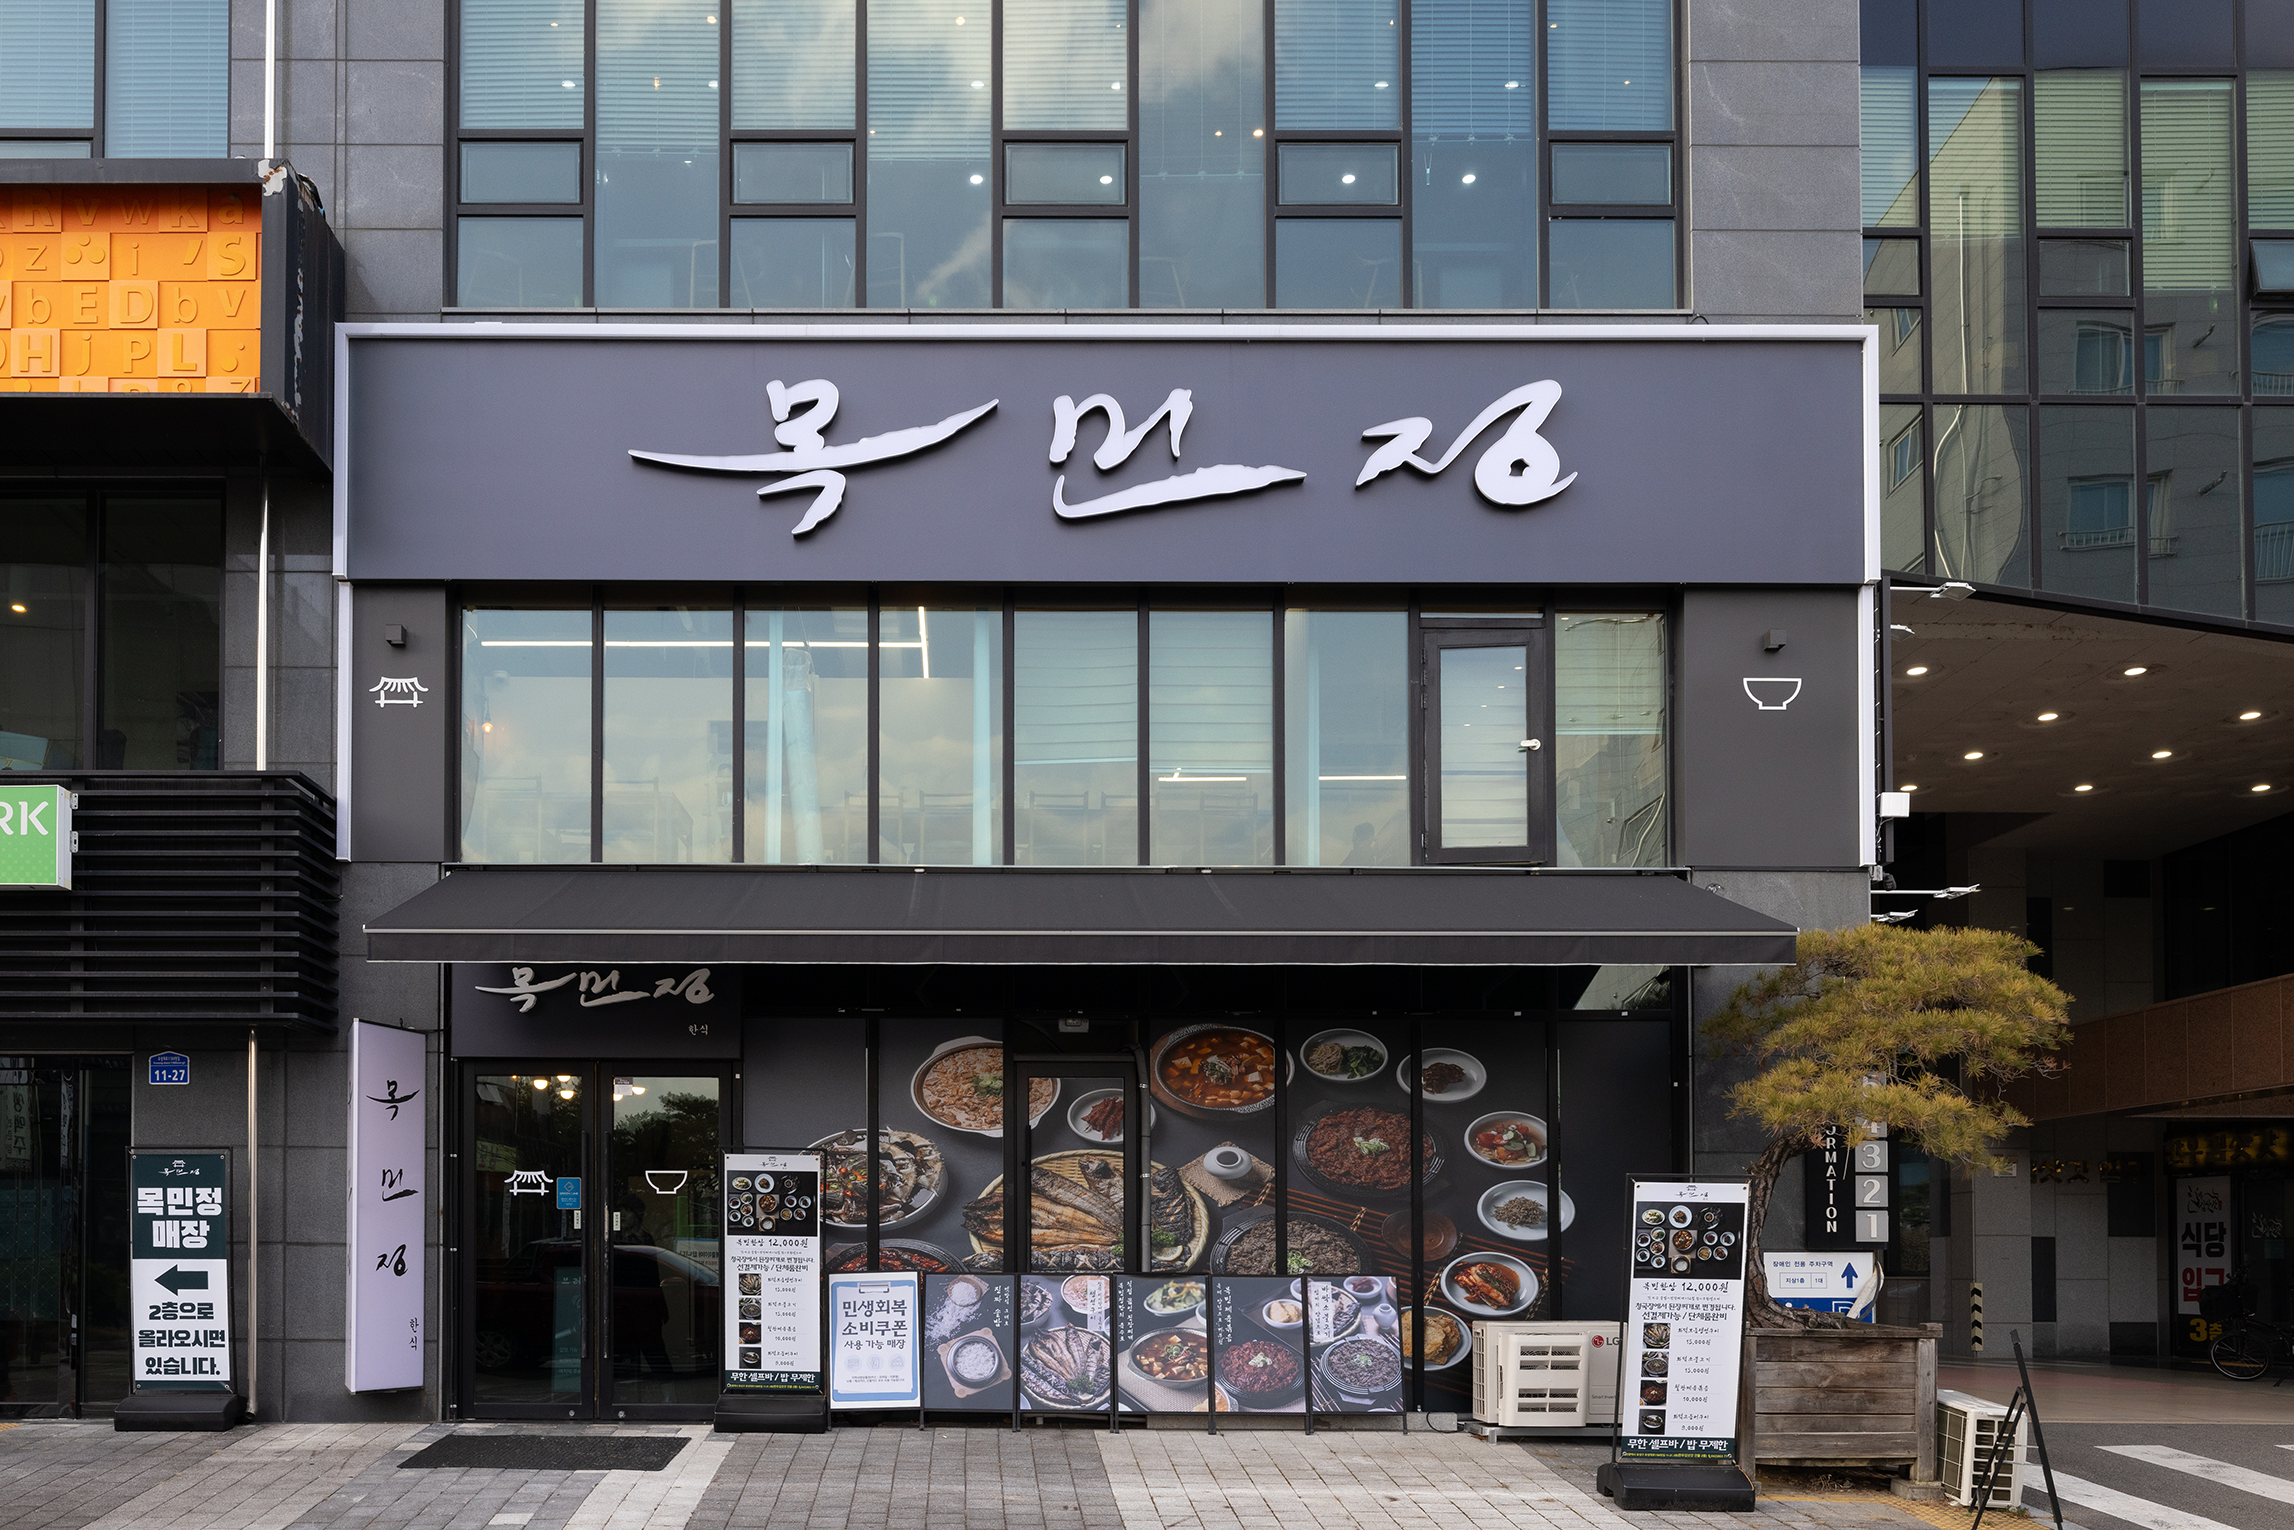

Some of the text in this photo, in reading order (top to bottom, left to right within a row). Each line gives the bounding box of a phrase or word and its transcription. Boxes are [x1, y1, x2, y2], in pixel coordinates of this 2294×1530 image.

[688, 1023, 709, 1036] 한식
[154, 1069, 186, 1081] 11-27
[1861, 1144, 1881, 1169] 3
[1862, 1179, 1881, 1204] 2
[137, 1187, 222, 1216] 목민정
[152, 1220, 210, 1249] 매장
[1866, 1214, 1878, 1238] 1
[2181, 1221, 2227, 1258] 식당
[148, 1301, 215, 1321] 2층으로
[842, 1299, 908, 1318] 민생회복
[409, 1317, 419, 1350] 한식
[842, 1320, 908, 1337] 소비쿠폰
[2189, 1318, 2223, 1342] 3층
[138, 1329, 226, 1348] 올라오시면
[844, 1339, 906, 1351] 사용 가능 매장
[1606, 1336, 1620, 1346] LG
[145, 1357, 221, 1376] 있습니다.
[790, 1373, 816, 1383] 무제한
[1627, 1438, 1648, 1450] 무한
[1648, 1438, 1679, 1450] 셀프바
[1686, 1439, 1698, 1451] 밥
[1698, 1439, 1729, 1451] 무제한
